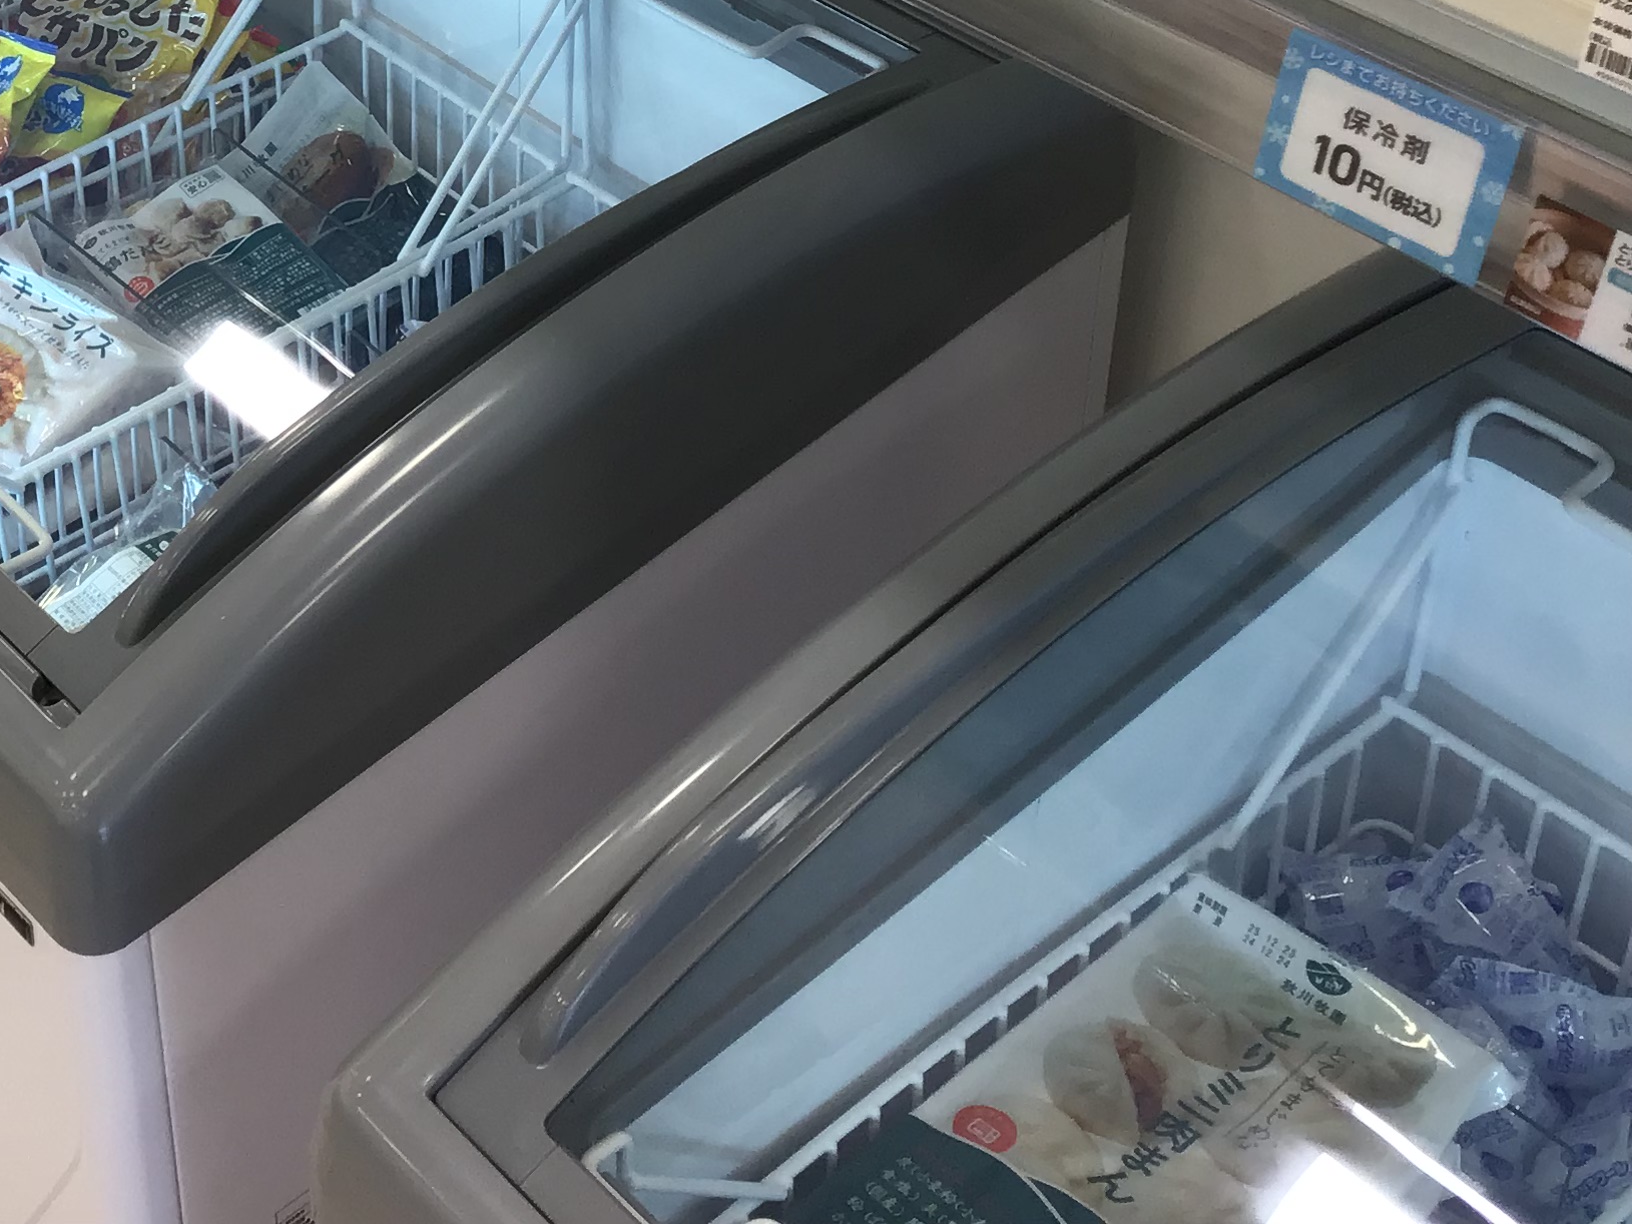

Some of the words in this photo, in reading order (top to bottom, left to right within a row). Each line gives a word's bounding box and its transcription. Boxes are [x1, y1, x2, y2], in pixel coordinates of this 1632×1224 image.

[1310, 43, 1491, 138] レジまでお持ちください
[1343, 106, 1431, 166] 保冷剤
[1312, 134, 1443, 229] 10円(税込)
[1267, 933, 1280, 948] 12
[1087, 1015, 1302, 1205] とりミニ肉まん
